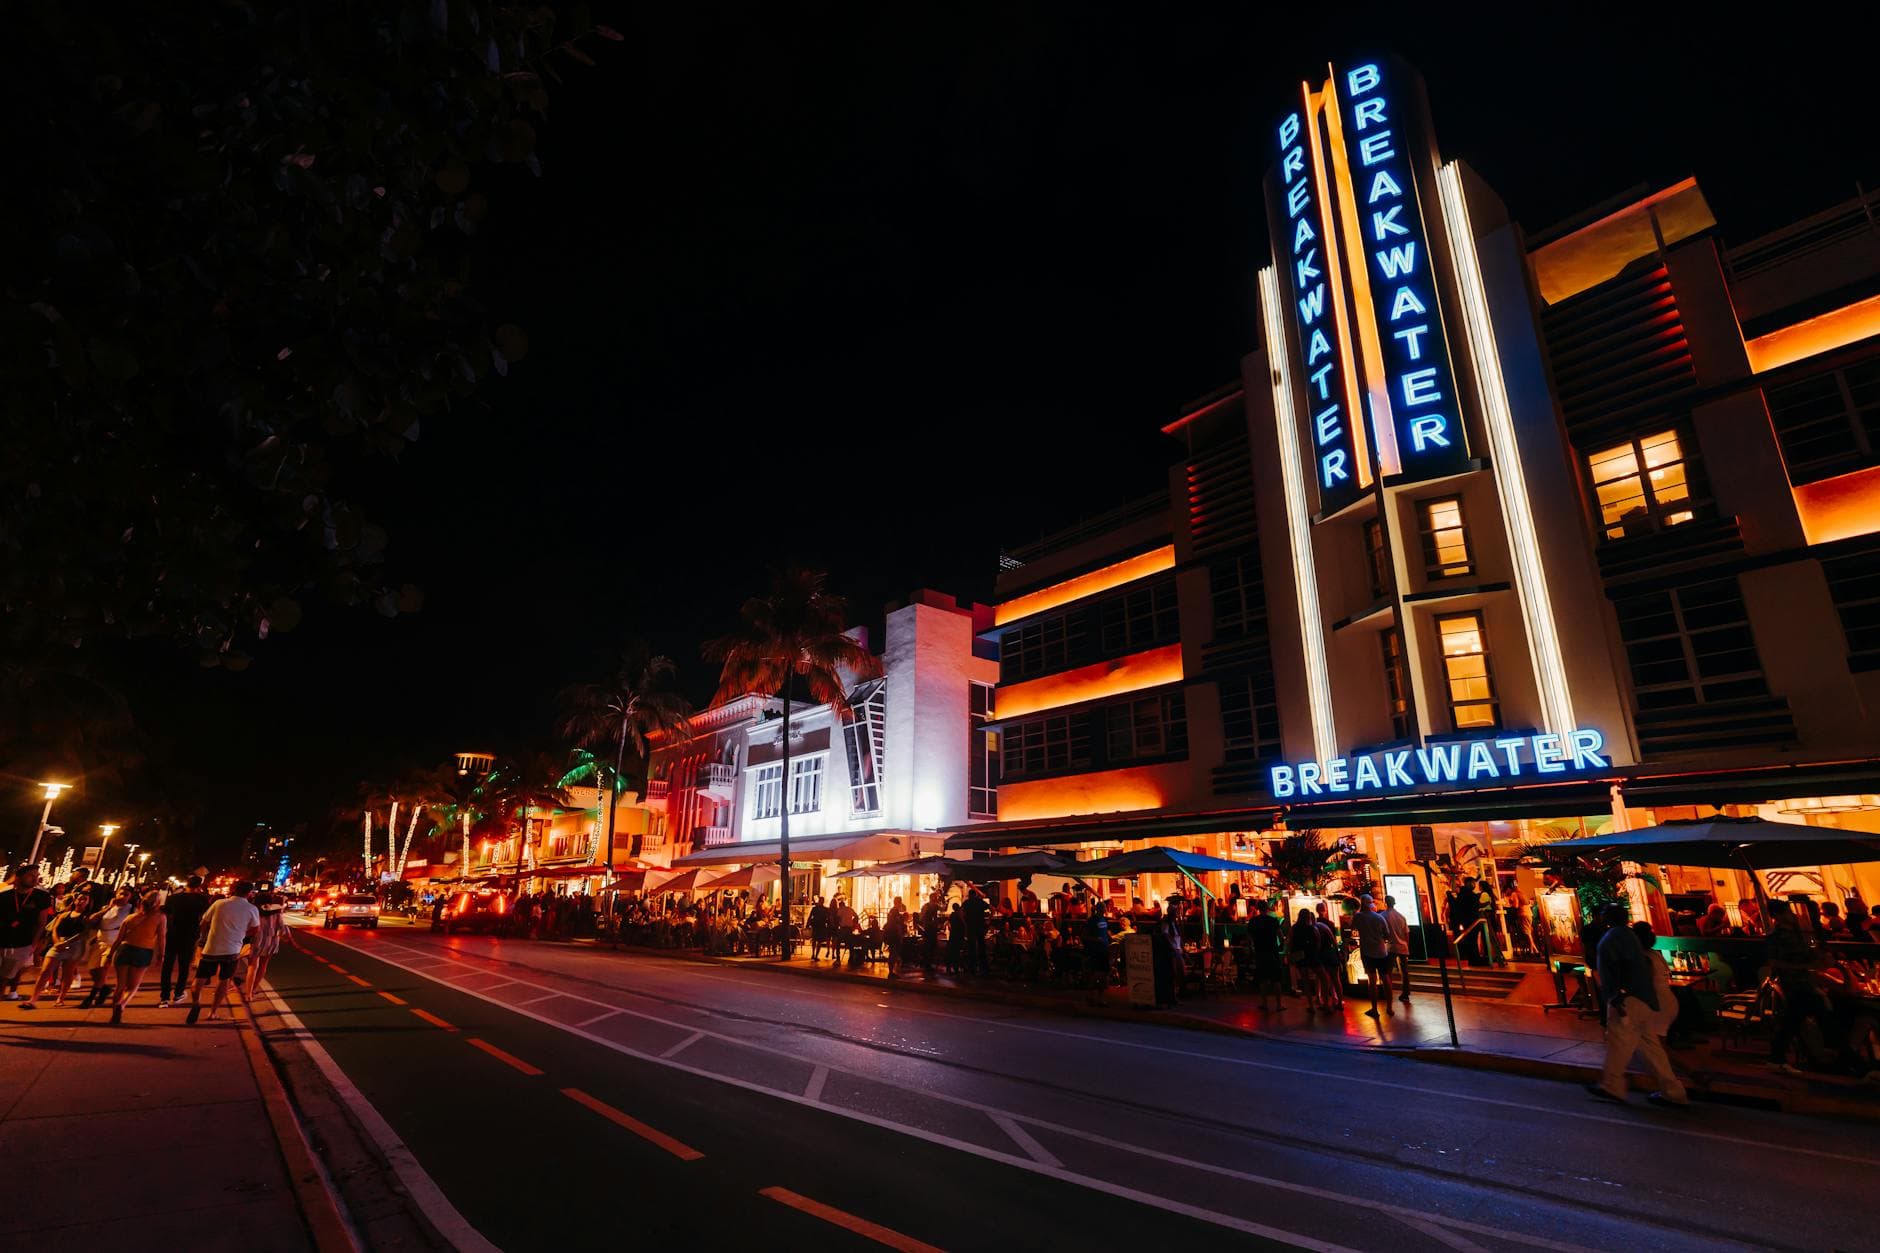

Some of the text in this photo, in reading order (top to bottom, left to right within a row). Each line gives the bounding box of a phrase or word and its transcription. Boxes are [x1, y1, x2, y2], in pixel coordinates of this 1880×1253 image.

[1279, 112, 1349, 488] BREAKWATER
[1348, 63, 1450, 452] BREAKWATER
[1271, 728, 1609, 798] BREAKWATER
